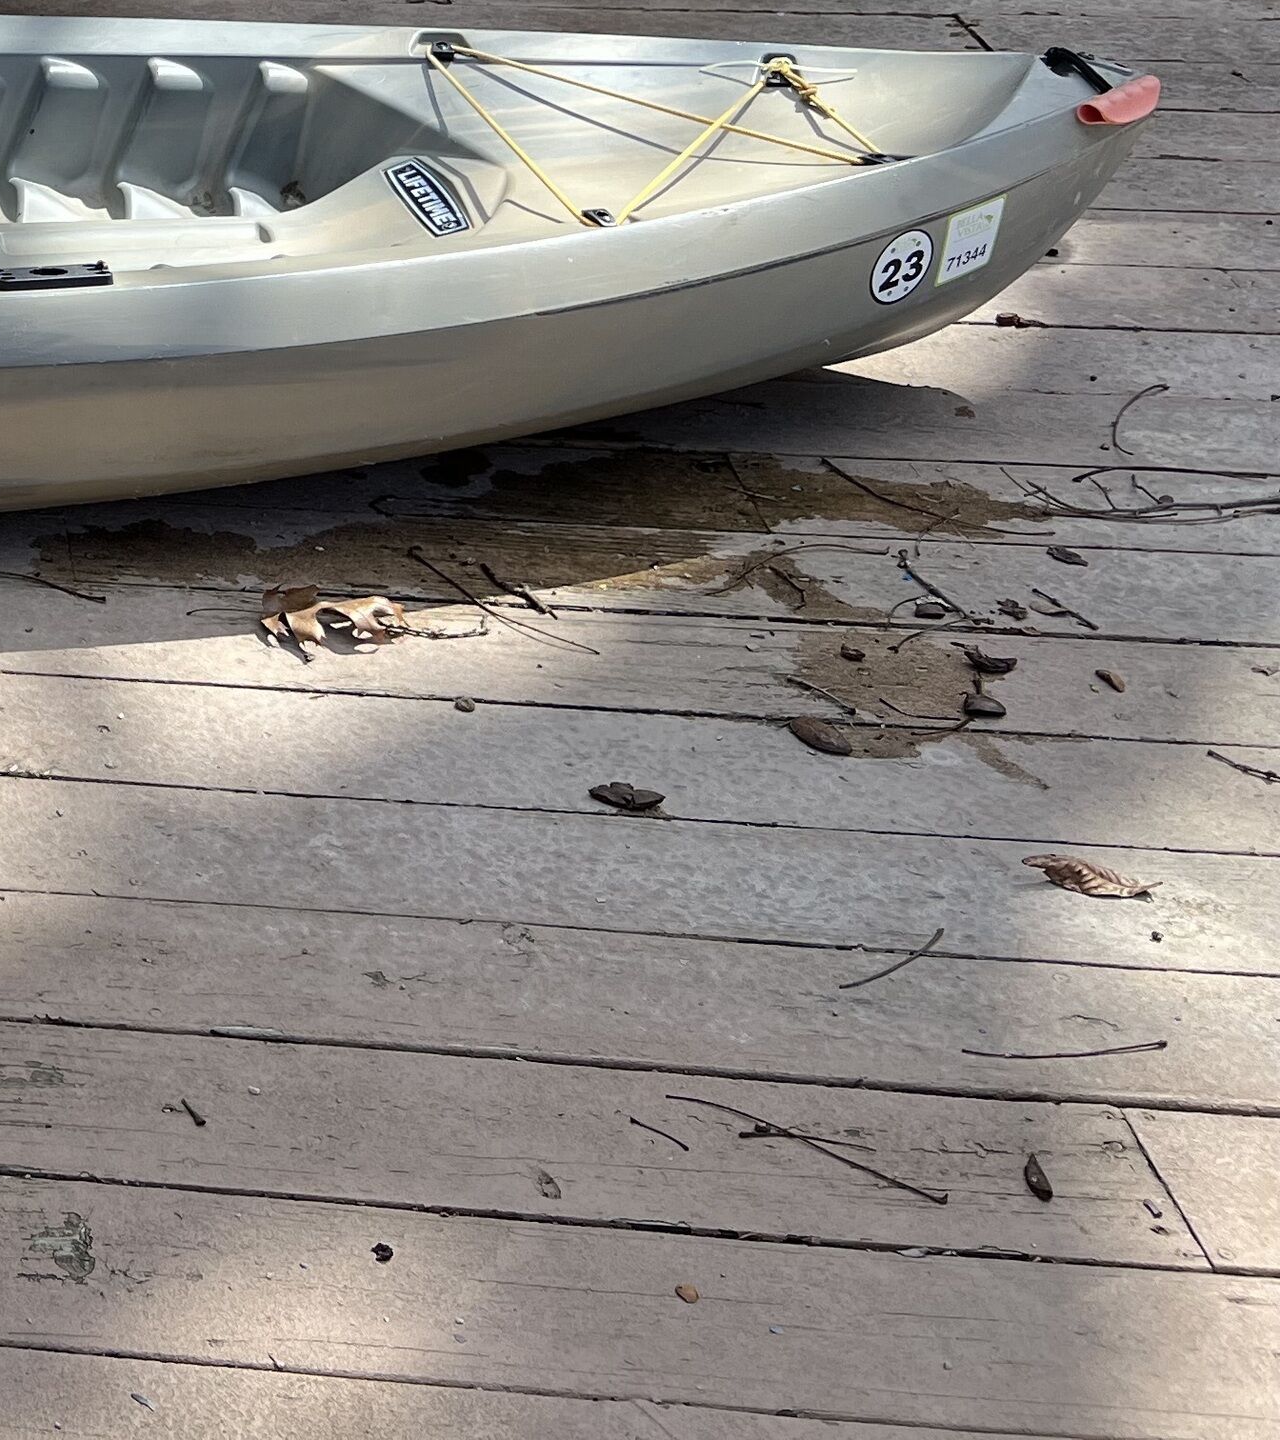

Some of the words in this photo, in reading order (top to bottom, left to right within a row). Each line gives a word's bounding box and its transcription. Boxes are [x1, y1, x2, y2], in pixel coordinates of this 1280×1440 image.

[397, 169, 458, 226] LIFETIME
[878, 249, 925, 293] 23
[946, 243, 988, 272] 71344
